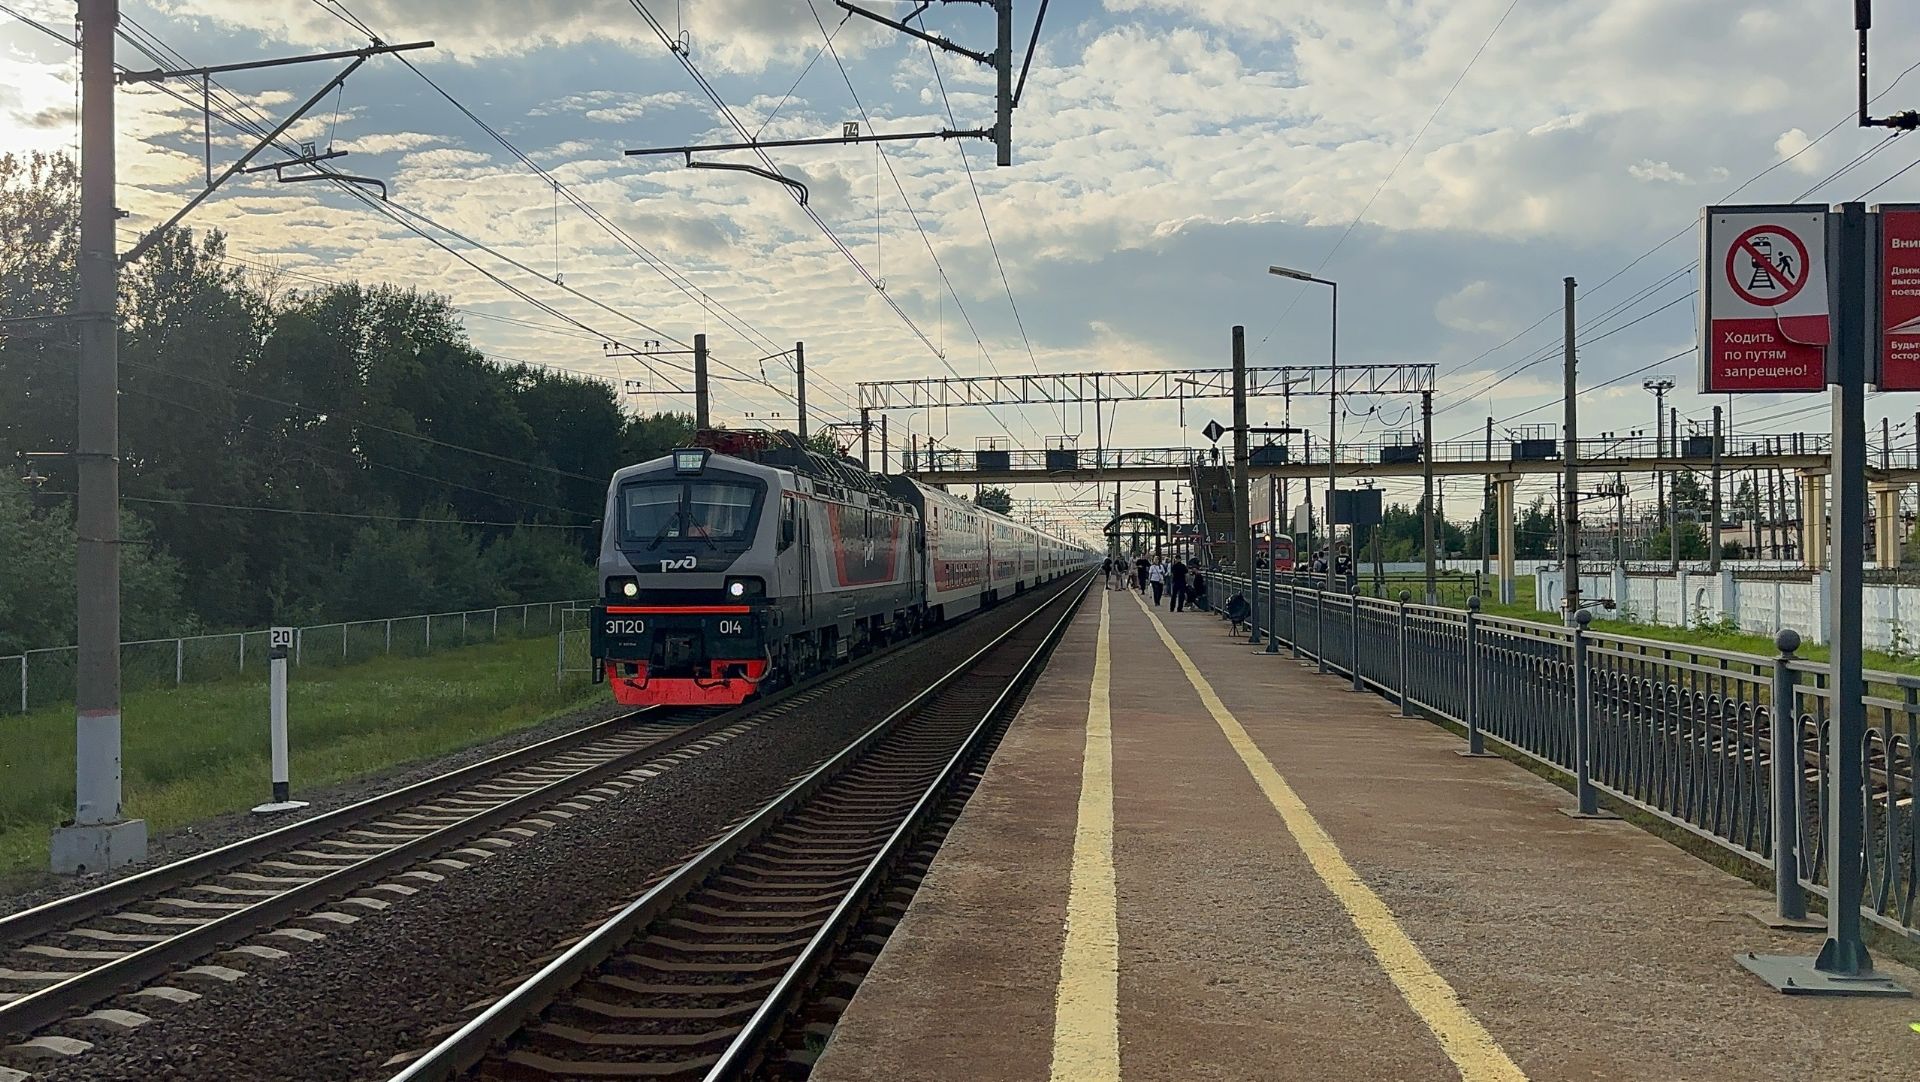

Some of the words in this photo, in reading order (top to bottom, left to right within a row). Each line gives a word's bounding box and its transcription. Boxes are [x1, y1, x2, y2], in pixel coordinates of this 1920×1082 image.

[843, 123, 858, 136] 74
[1724, 331, 1775, 344] Ходить
[1724, 351, 1742, 360] по
[1745, 350, 1787, 362] путям
[1724, 364, 1807, 379] запрещено!
[1175, 524, 1182, 534] 2
[1192, 524, 1199, 534] 4
[606, 620, 645, 634] ЭП20
[719, 620, 742, 634] 014
[272, 630, 290, 643] 20
